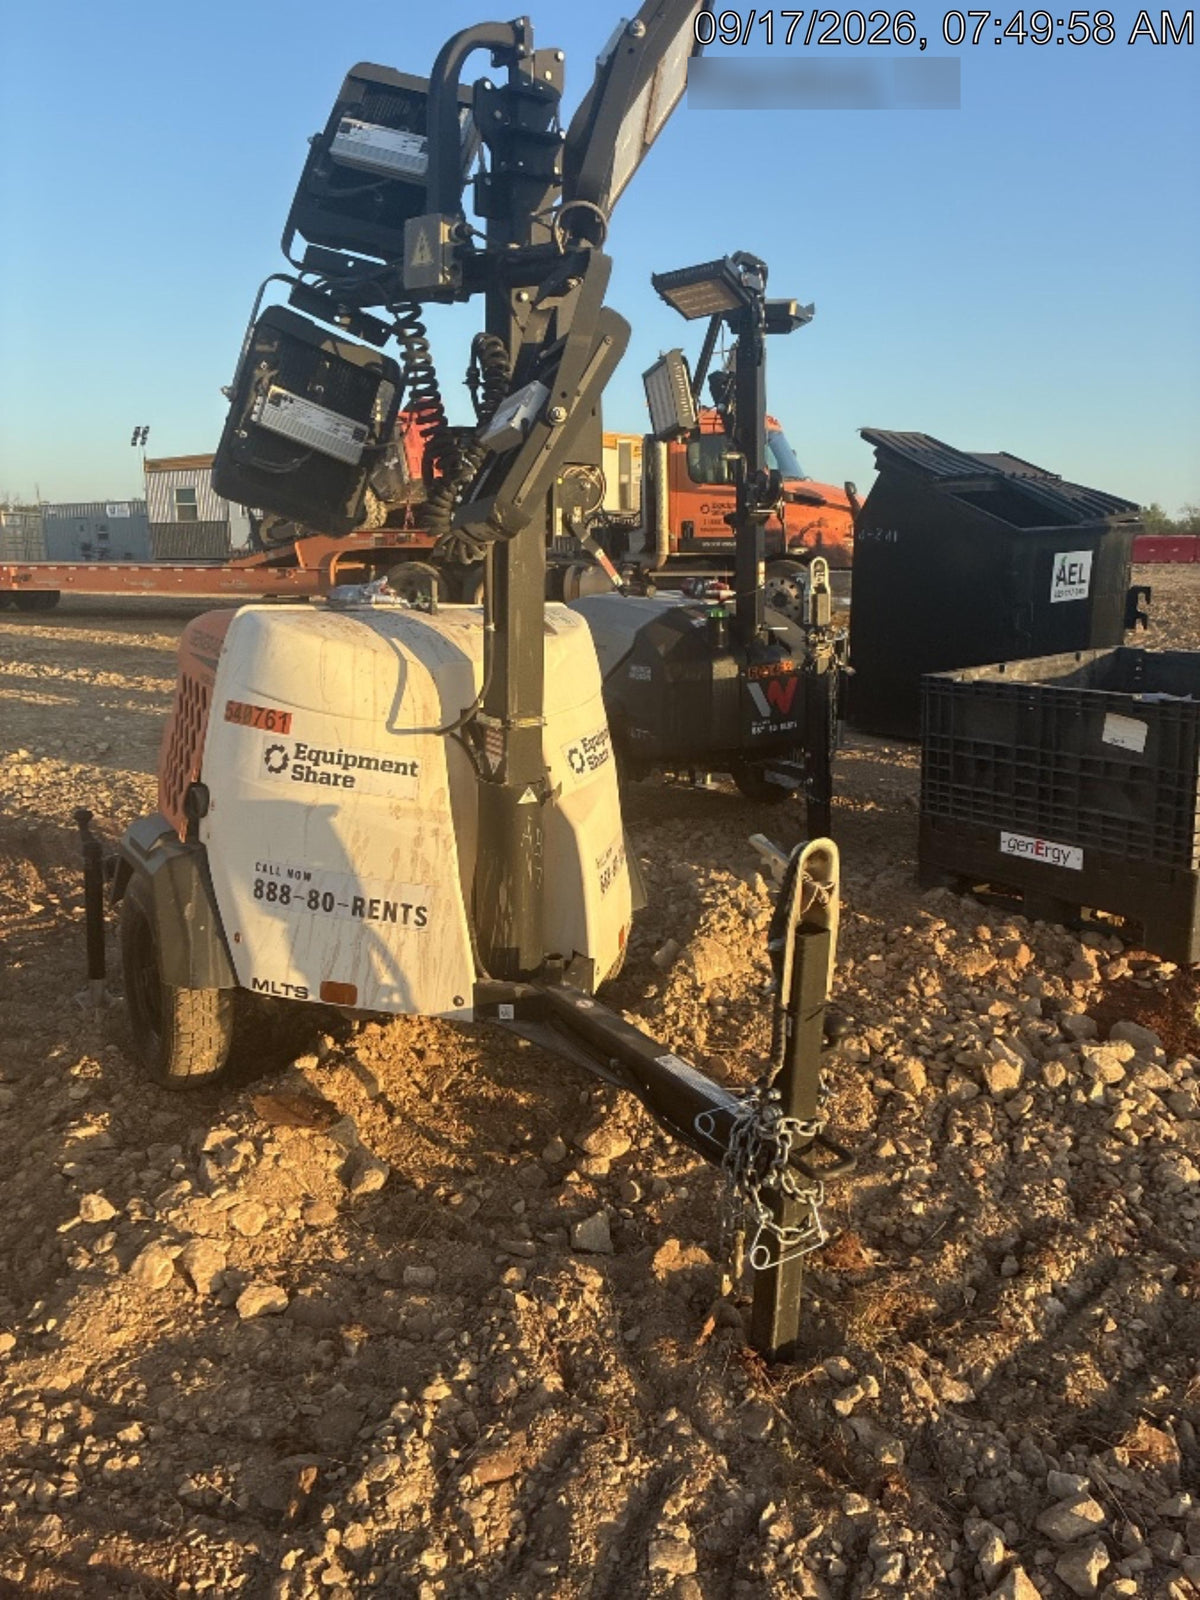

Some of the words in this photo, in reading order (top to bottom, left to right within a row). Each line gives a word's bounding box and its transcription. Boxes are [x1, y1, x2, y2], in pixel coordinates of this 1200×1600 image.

[1056, 563, 1087, 587] AEL
[293, 743, 419, 777] Equipment
[291, 764, 356, 788] Share
[255, 862, 281, 877] CALL
[287, 868, 312, 882] NOW
[253, 878, 428, 927] 888-80-RENTS
[252, 978, 309, 999] MLTS
